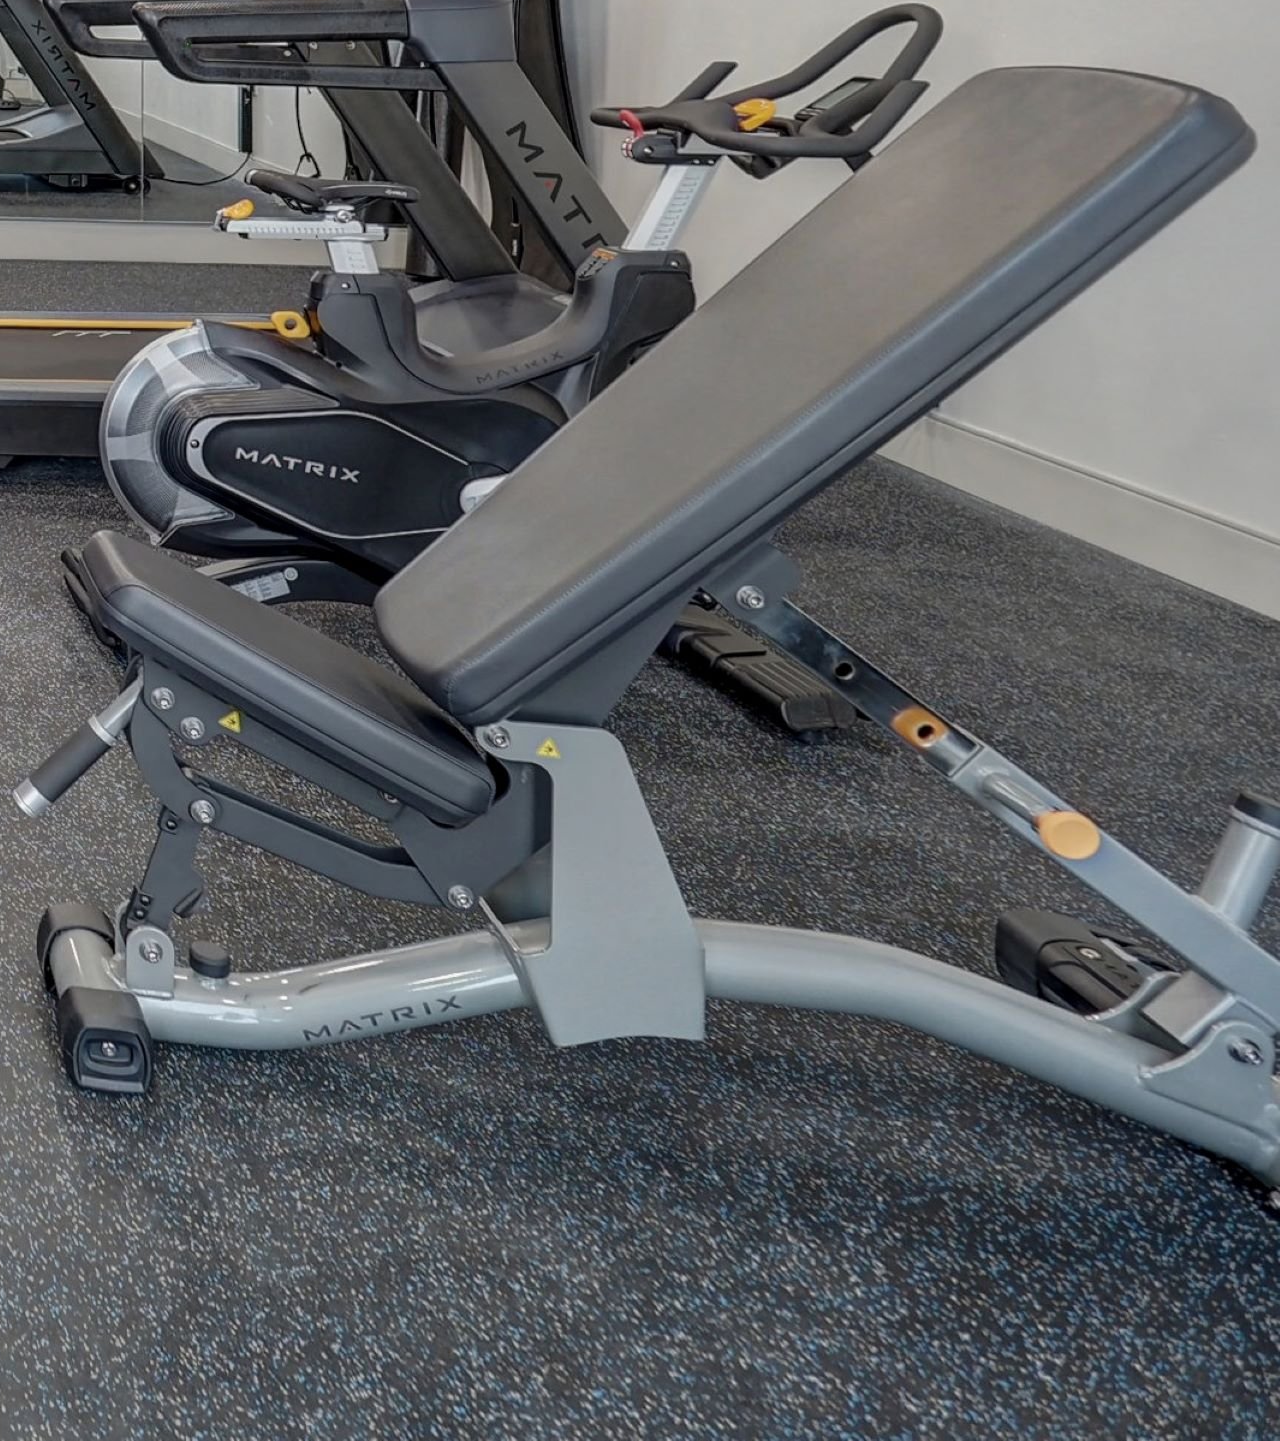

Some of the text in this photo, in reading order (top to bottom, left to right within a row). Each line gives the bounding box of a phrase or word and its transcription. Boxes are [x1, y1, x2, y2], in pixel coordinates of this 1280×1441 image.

[475, 351, 564, 385] MATRIX
[235, 446, 361, 483] MATRIX
[302, 995, 462, 1042] MATRIX
